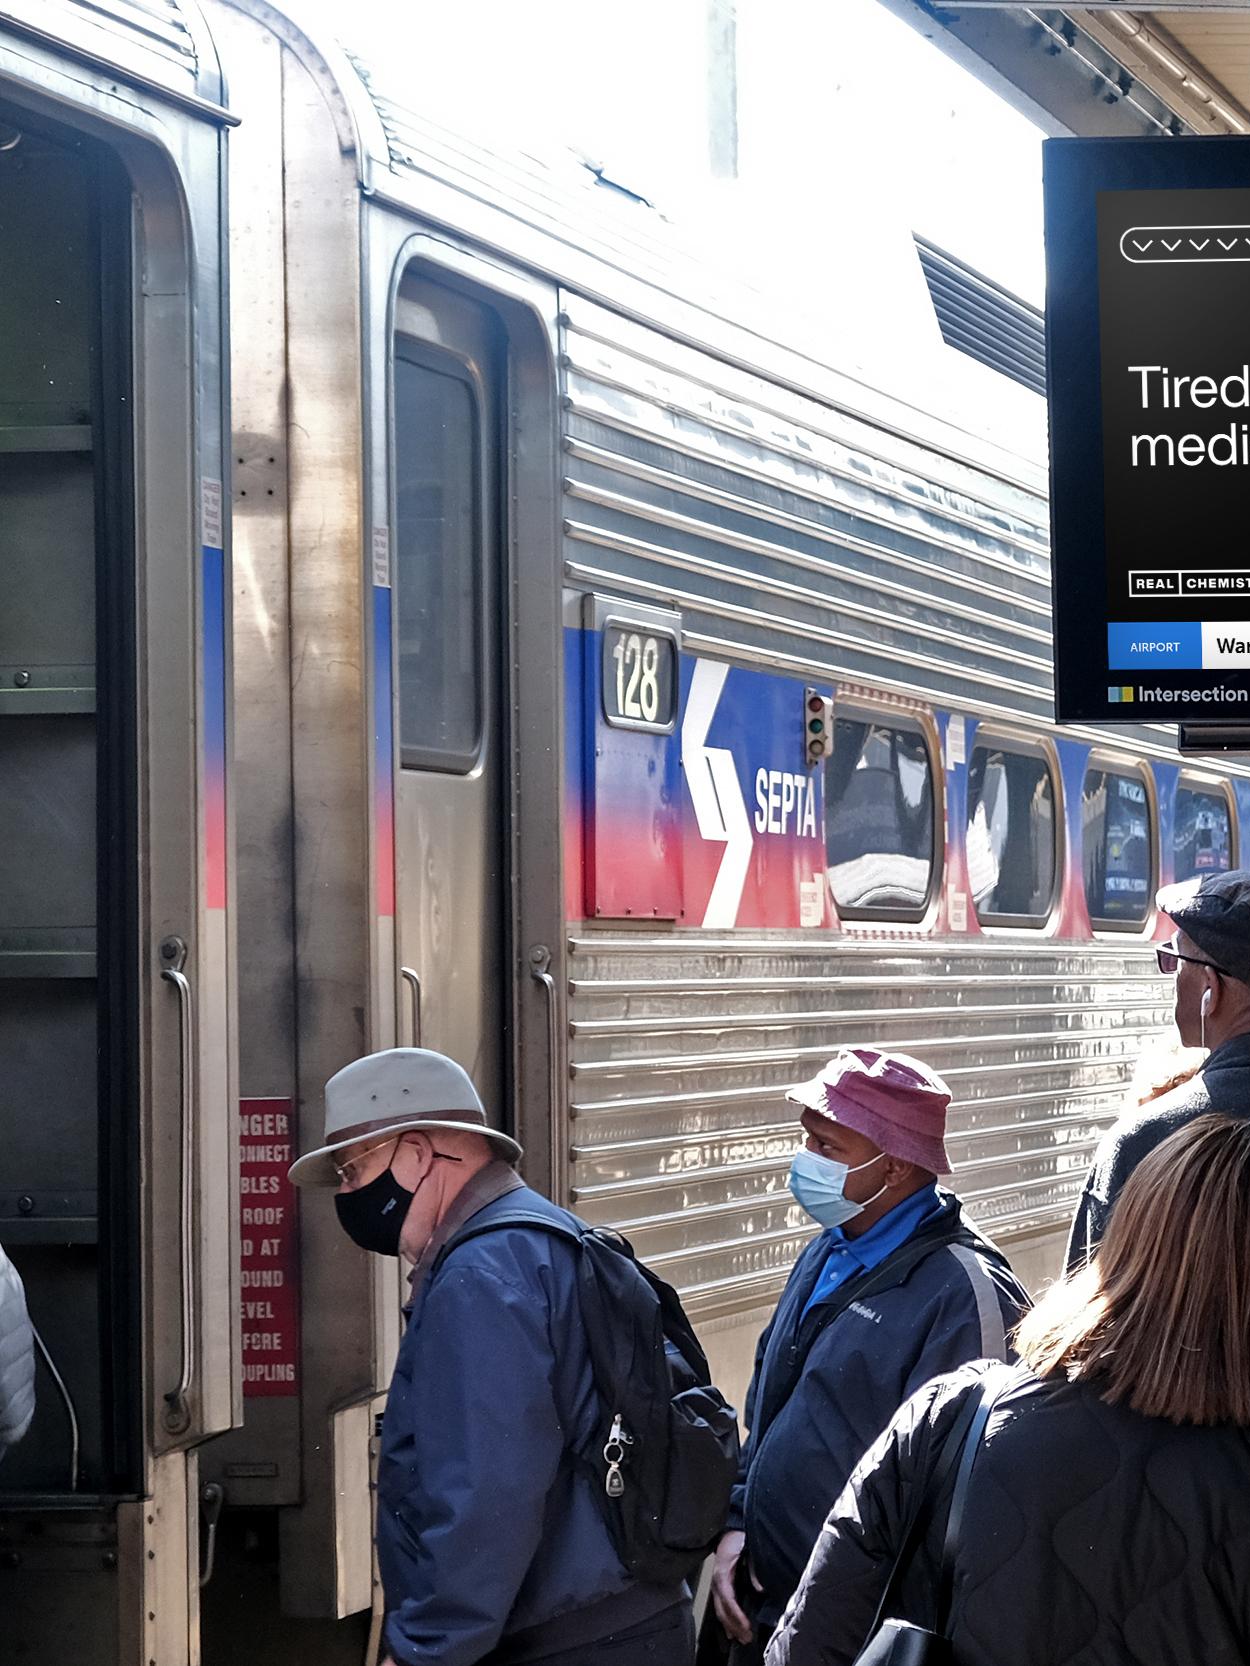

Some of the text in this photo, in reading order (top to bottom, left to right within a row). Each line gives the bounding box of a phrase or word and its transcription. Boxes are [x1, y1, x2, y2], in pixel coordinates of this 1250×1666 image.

[1127, 364, 1250, 409] Tired
[1135, 577, 1175, 590] REAL
[1130, 641, 1181, 653] AIRPORT
[612, 632, 660, 722] 128
[1138, 684, 1248, 703] Intersection
[754, 768, 817, 838] SEPTA
[240, 1114, 289, 1136] NGER
[240, 1144, 290, 1162] ONNECT
[240, 1176, 280, 1194] BLES
[243, 1207, 284, 1225] ROOF
[260, 1239, 281, 1256] AT
[241, 1270, 284, 1288] OUND
[241, 1301, 274, 1319] EVEL
[242, 1332, 282, 1350] FORE
[241, 1364, 296, 1382] OUPLING
